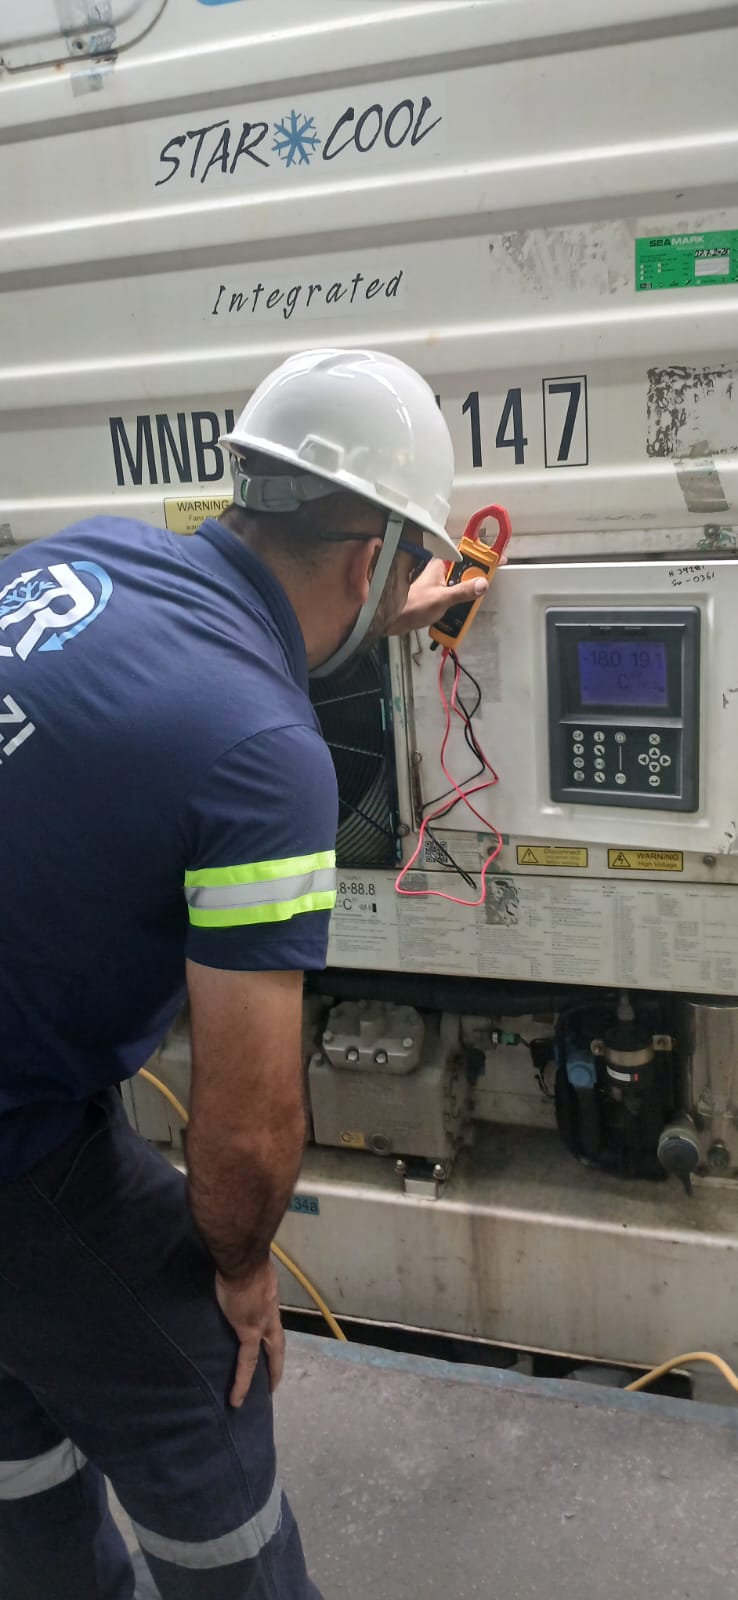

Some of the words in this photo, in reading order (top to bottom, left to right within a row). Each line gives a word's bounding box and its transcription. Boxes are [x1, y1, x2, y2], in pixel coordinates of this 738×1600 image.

[155, 120, 270, 186] STAR
[322, 97, 442, 160] COOL
[649, 235, 704, 248] SEAMARK
[212, 270, 403, 320] Integrated
[435, 387, 528, 468] 14
[177, 500, 229, 512] WARNING
[636, 852, 680, 861] WARNING
